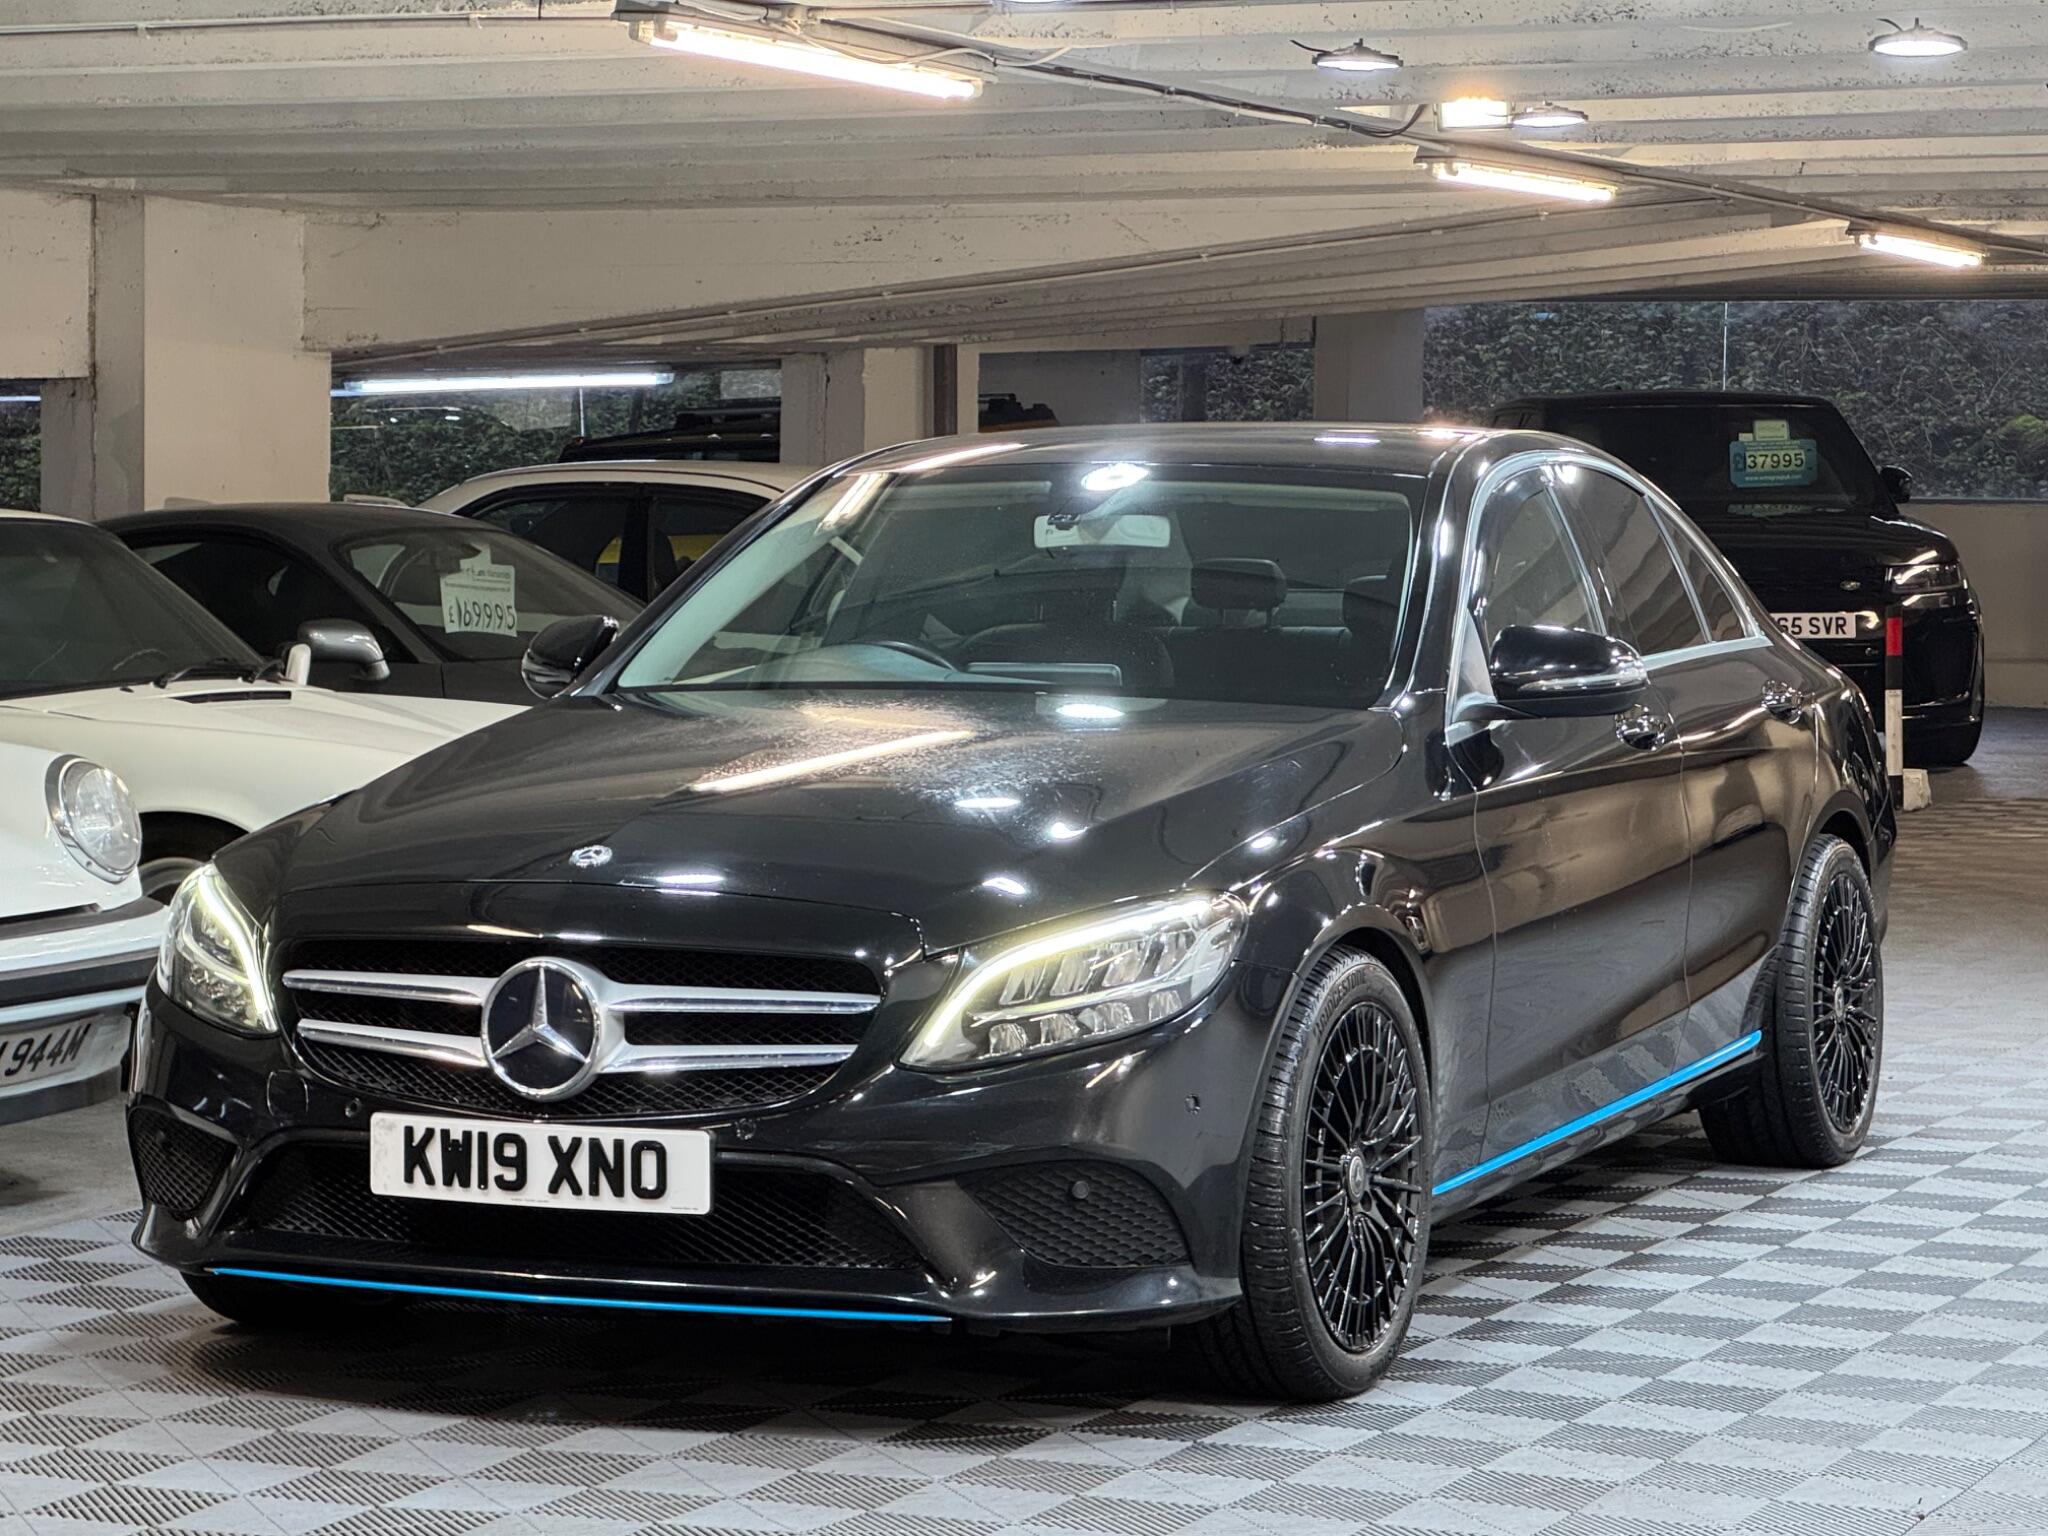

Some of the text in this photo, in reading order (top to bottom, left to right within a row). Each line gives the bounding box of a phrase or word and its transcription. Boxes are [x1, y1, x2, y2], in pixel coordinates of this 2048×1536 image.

[1809, 617, 1847, 635] SVR
[4, 1023, 92, 1076] 944M
[403, 1125, 667, 1200] KW19 XNO
